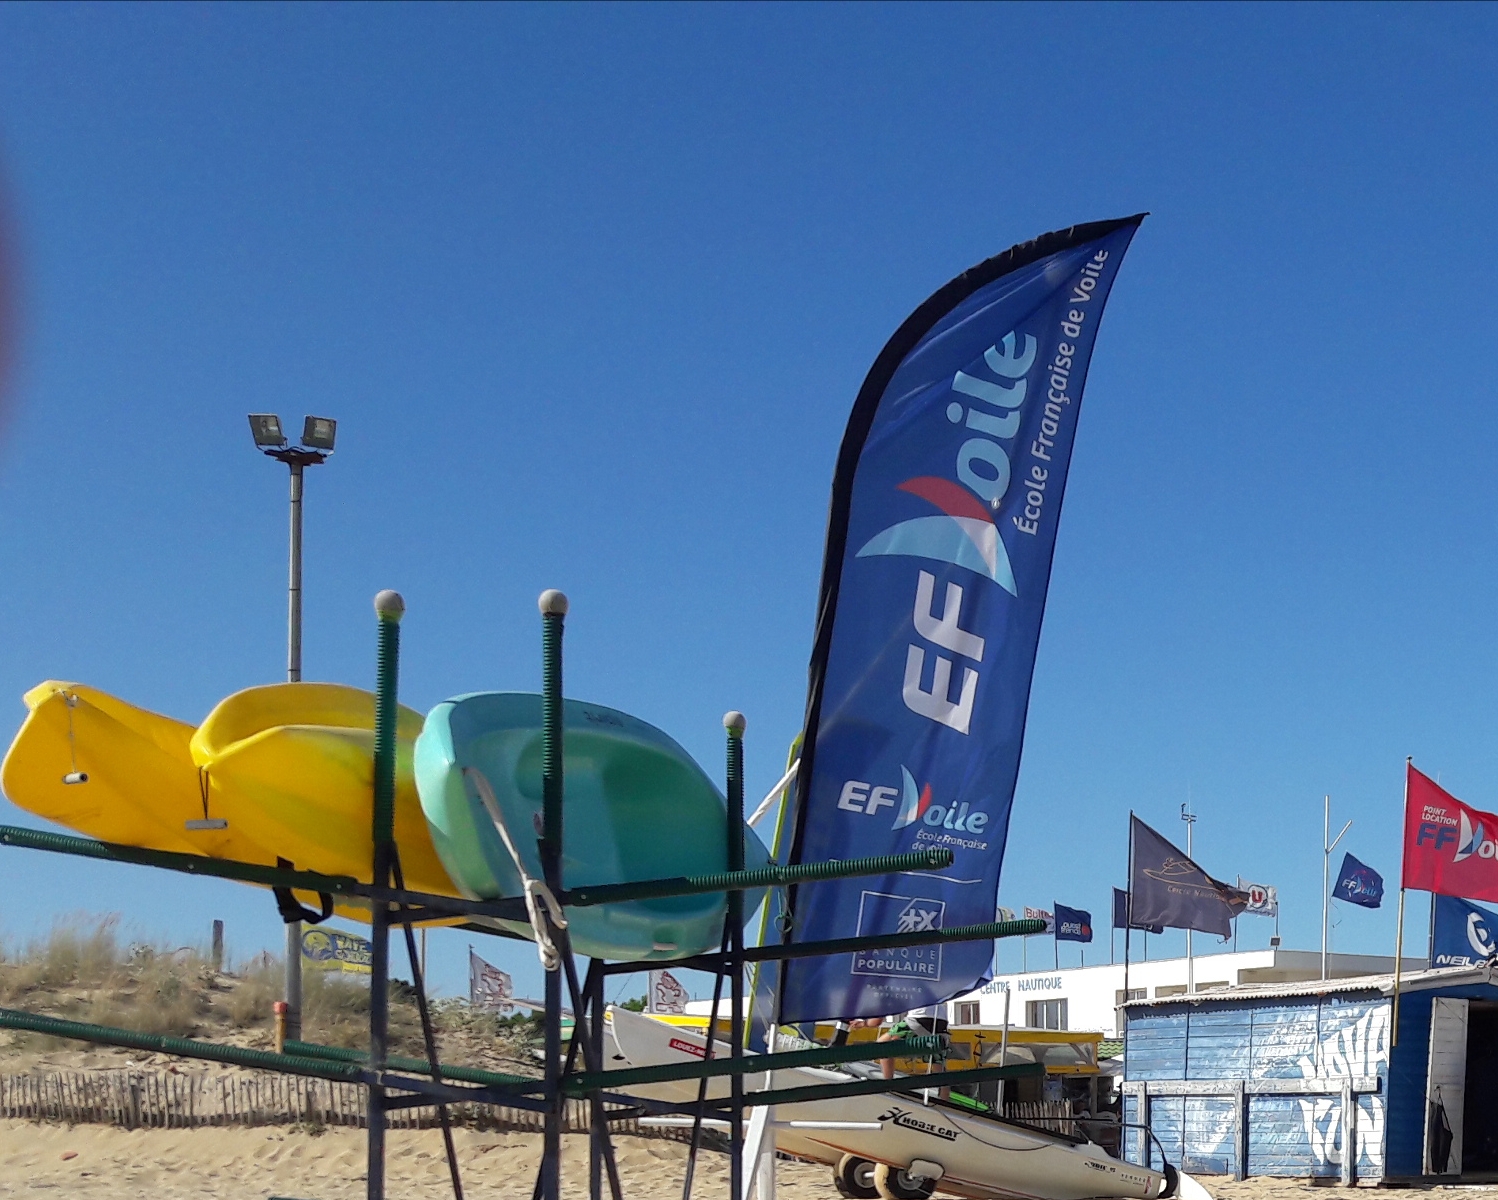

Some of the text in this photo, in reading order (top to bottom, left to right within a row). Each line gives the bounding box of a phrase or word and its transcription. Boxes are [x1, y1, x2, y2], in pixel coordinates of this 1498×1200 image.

[1012, 249, 1109, 536] École Française de Voile
[1423, 805, 1447, 816] POINT
[1421, 812, 1459, 826] LOCATION
[941, 834, 988, 850] Française
[1251, 889, 1263, 903] U
[859, 948, 936, 960] BANQUE
[857, 959, 935, 974] POPULAIRE
[1017, 977, 1063, 991] NAUTIQUE
[938, 1126, 962, 1138] CAT
